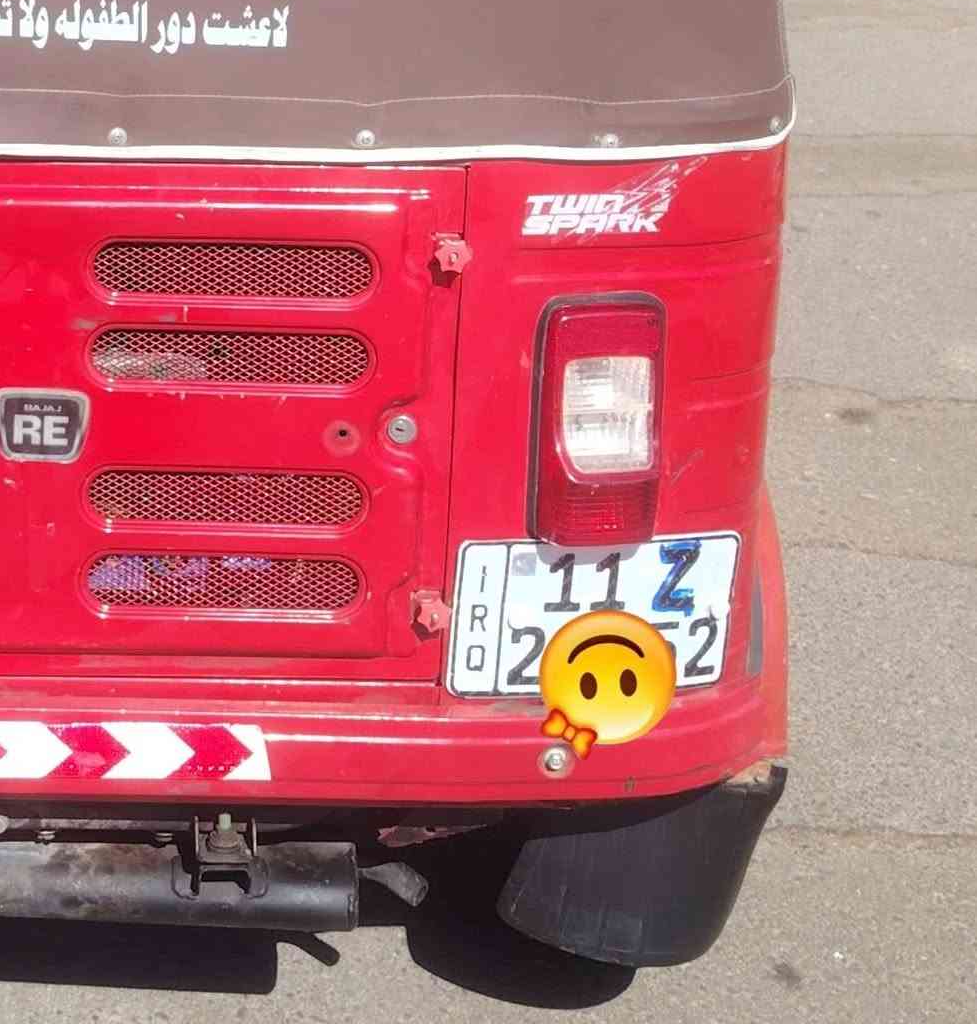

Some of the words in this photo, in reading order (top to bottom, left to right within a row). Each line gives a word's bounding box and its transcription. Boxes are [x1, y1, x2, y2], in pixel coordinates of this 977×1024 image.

[54, 0, 148, 51] الطفوله
[150, 11, 196, 55] دور
[521, 212, 661, 235] SPARK
[12, 414, 70, 446] RE
[543, 552, 626, 613] 11
